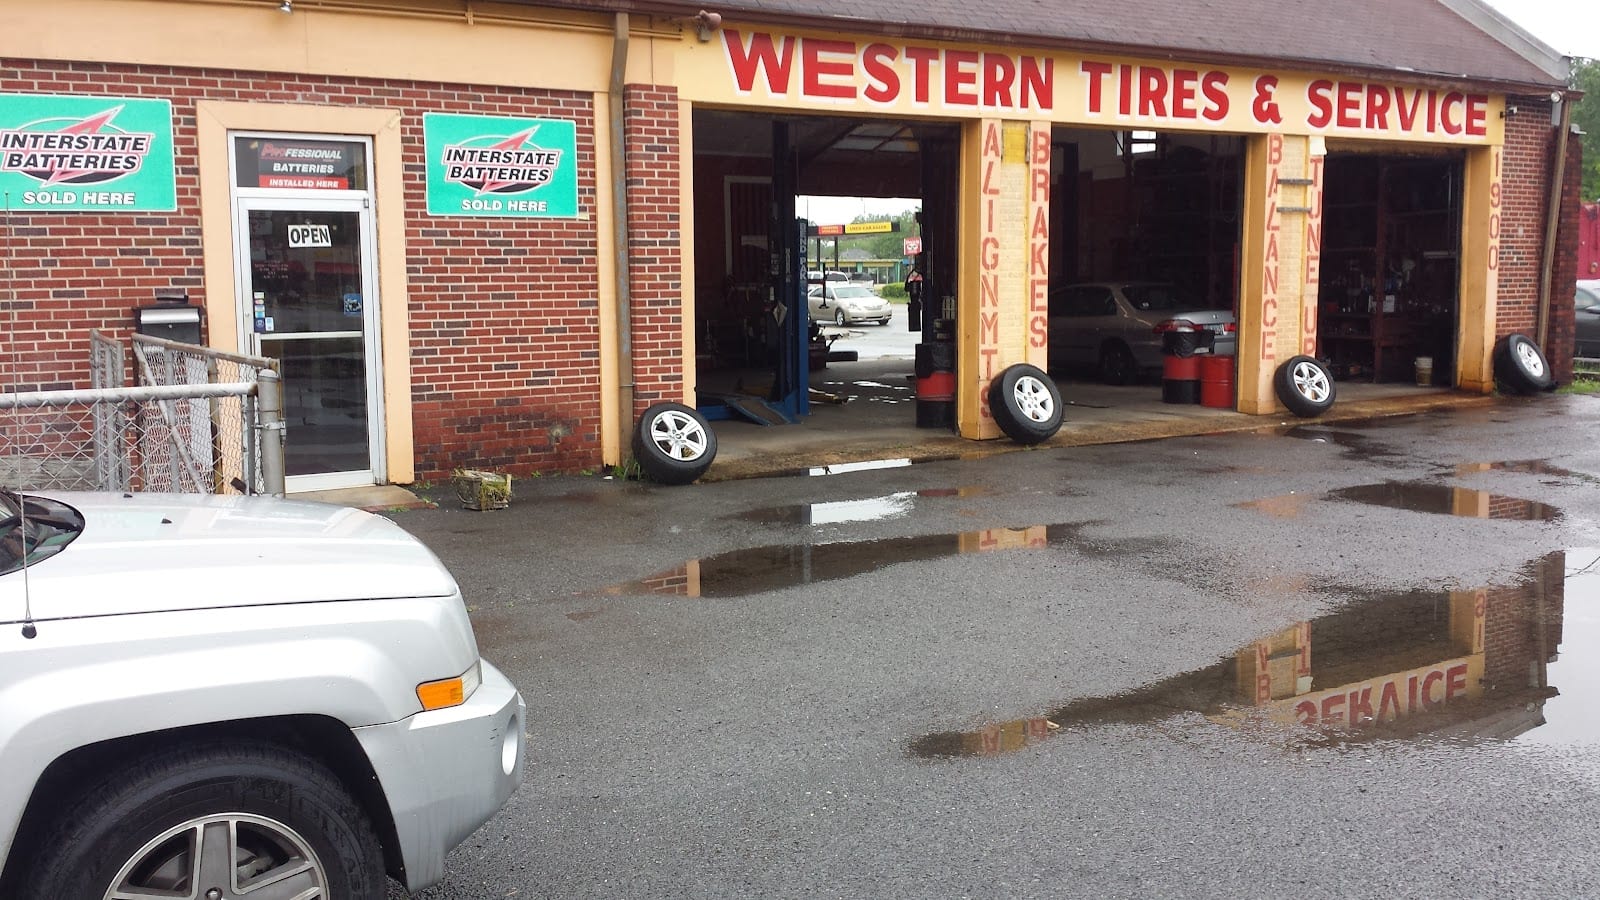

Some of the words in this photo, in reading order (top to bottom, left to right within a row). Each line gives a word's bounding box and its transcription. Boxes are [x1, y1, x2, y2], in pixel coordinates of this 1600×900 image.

[722, 28, 1054, 110] WESTERN
[1081, 60, 1231, 122] TIRES
[1252, 74, 1283, 125] &
[1306, 78, 1489, 136] SERVICE
[1, 133, 147, 151] INTERSTATE
[7, 153, 138, 170] BATTERIES
[446, 148, 558, 166] INTERSTATE
[273, 162, 335, 174] BATTERIES
[449, 165, 550, 182] BATTERIES
[269, 178, 315, 188] INSTALLED
[316, 179, 339, 188] HERE
[22, 190, 77, 205] SOLD
[82, 191, 136, 205] HERE
[461, 199, 503, 212] SOLD
[507, 201, 548, 213] HERE
[1488, 151, 1500, 272] 1900
[1306, 157, 1324, 285] TUNE
[290, 226, 330, 244] OPEN
[1030, 130, 1050, 349] BRAKES
[1261, 135, 1283, 360] BALANCE
[1303, 306, 1318, 356] UP
